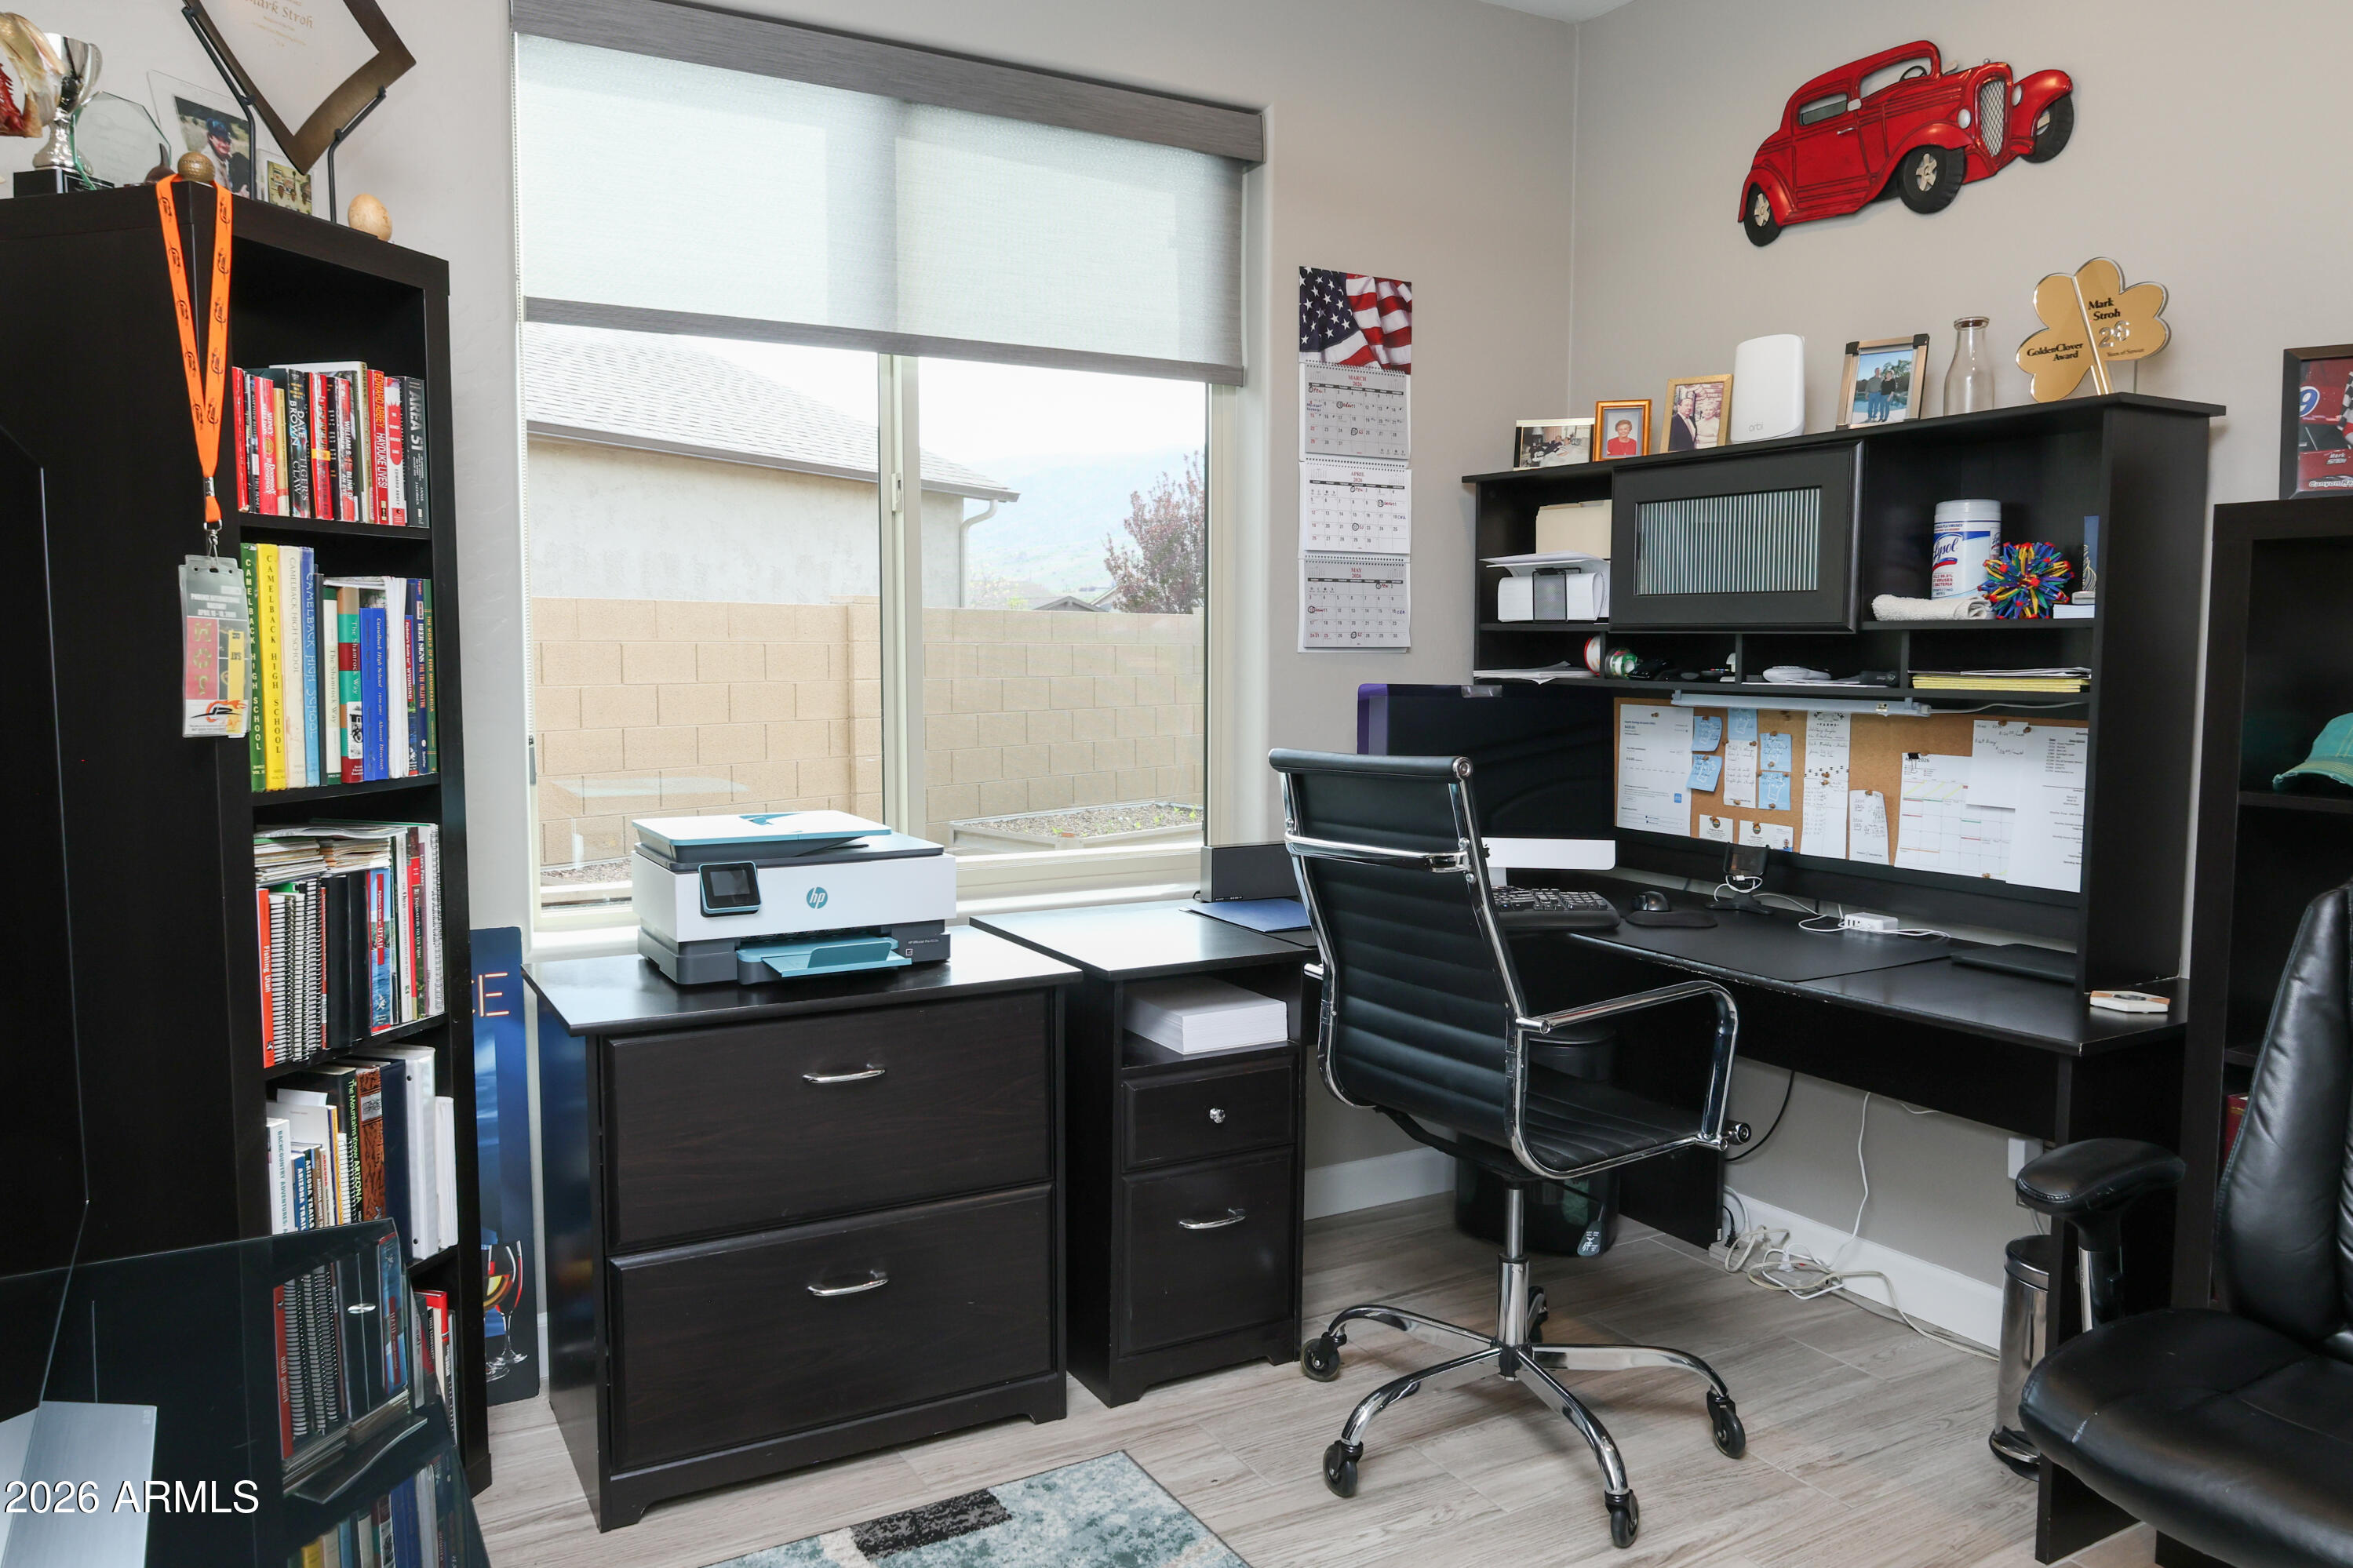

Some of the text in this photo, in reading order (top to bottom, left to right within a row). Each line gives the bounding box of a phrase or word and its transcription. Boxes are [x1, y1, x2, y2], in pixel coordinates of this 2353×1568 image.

[282, 6, 314, 28] Stroh
[2088, 297, 2114, 311] Mark
[2093, 308, 2121, 321] Stroh
[2027, 342, 2084, 357] GoldenClover
[2098, 320, 2130, 347] 26
[2053, 351, 2078, 362] Award
[374, 373, 384, 428] EDWARD ABBEY
[409, 391, 424, 451] AREA 51
[290, 400, 298, 446] BROWN
[1749, 422, 1764, 431] orbi
[293, 460, 301, 496] CLAW
[300, 457, 308, 501] TIGER'S
[376, 432, 388, 489] HAYDUKE LIVES!
[289, 557, 297, 610] CAMELBACK
[266, 555, 276, 645] CAMELBACK
[271, 653, 279, 689] HIGH
[245, 558, 257, 645] CAMELBACK
[253, 697, 261, 751] SCHOOL
[306, 573, 317, 739] CAMELBACK HIGH SCHOOL
[810, 887, 826, 909] hp
[348, 1079, 358, 1094] The
[349, 1095, 359, 1136] Mountains
[277, 1130, 287, 1179] BACKCOUNTRY
